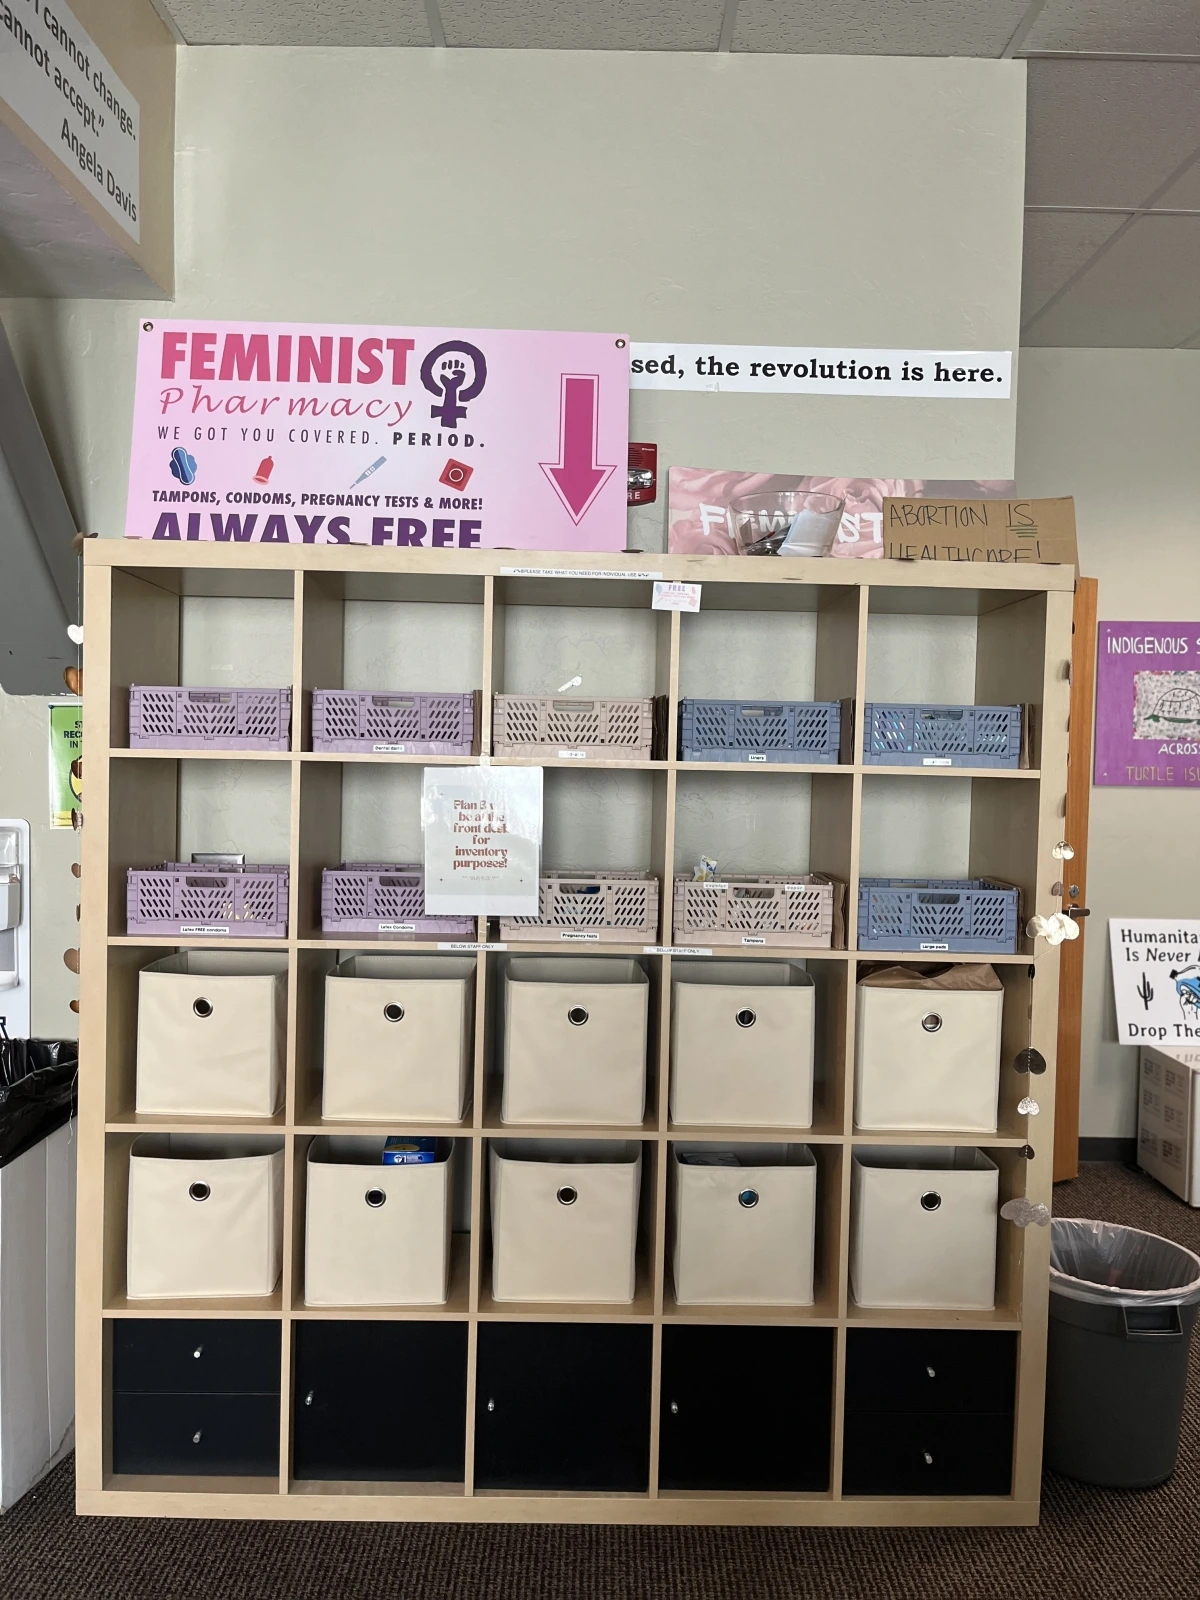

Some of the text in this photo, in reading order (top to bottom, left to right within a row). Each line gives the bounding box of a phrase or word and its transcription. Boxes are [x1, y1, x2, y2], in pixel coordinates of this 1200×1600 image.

[0, 0, 51, 77] annot
[43, 7, 136, 141] cannot change.
[61, 118, 137, 222] Angela Davis
[161, 331, 415, 385] FEMINIST
[630, 355, 1003, 383] sed, the revolution is here.
[160, 384, 413, 427] Pharmacy
[157, 426, 486, 448] WE GOT YOU COVERED. PERIOD.
[152, 490, 484, 510] TAMPONS, CONDOMS, PREGNANCY TESTS & MORE!
[890, 503, 1037, 528] ABORTION IS
[371, 517, 483, 549] FREE
[668, 584, 686, 593] FREE
[1107, 637, 1189, 655] INDIGENOUS
[69, 741, 79, 749] IN
[1158, 743, 1200, 755] ACROS
[1126, 766, 1174, 780] TURTLE
[454, 800, 477, 810] Plan
[453, 823, 481, 833] front
[472, 834, 491, 845] for
[455, 845, 508, 859] inventory
[453, 858, 508, 871] purposes!
[1121, 929, 1200, 944] Humanita
[1126, 947, 1140, 962] Is
[1145, 947, 1191, 963] Never
[1128, 1023, 1167, 1040] Drop
